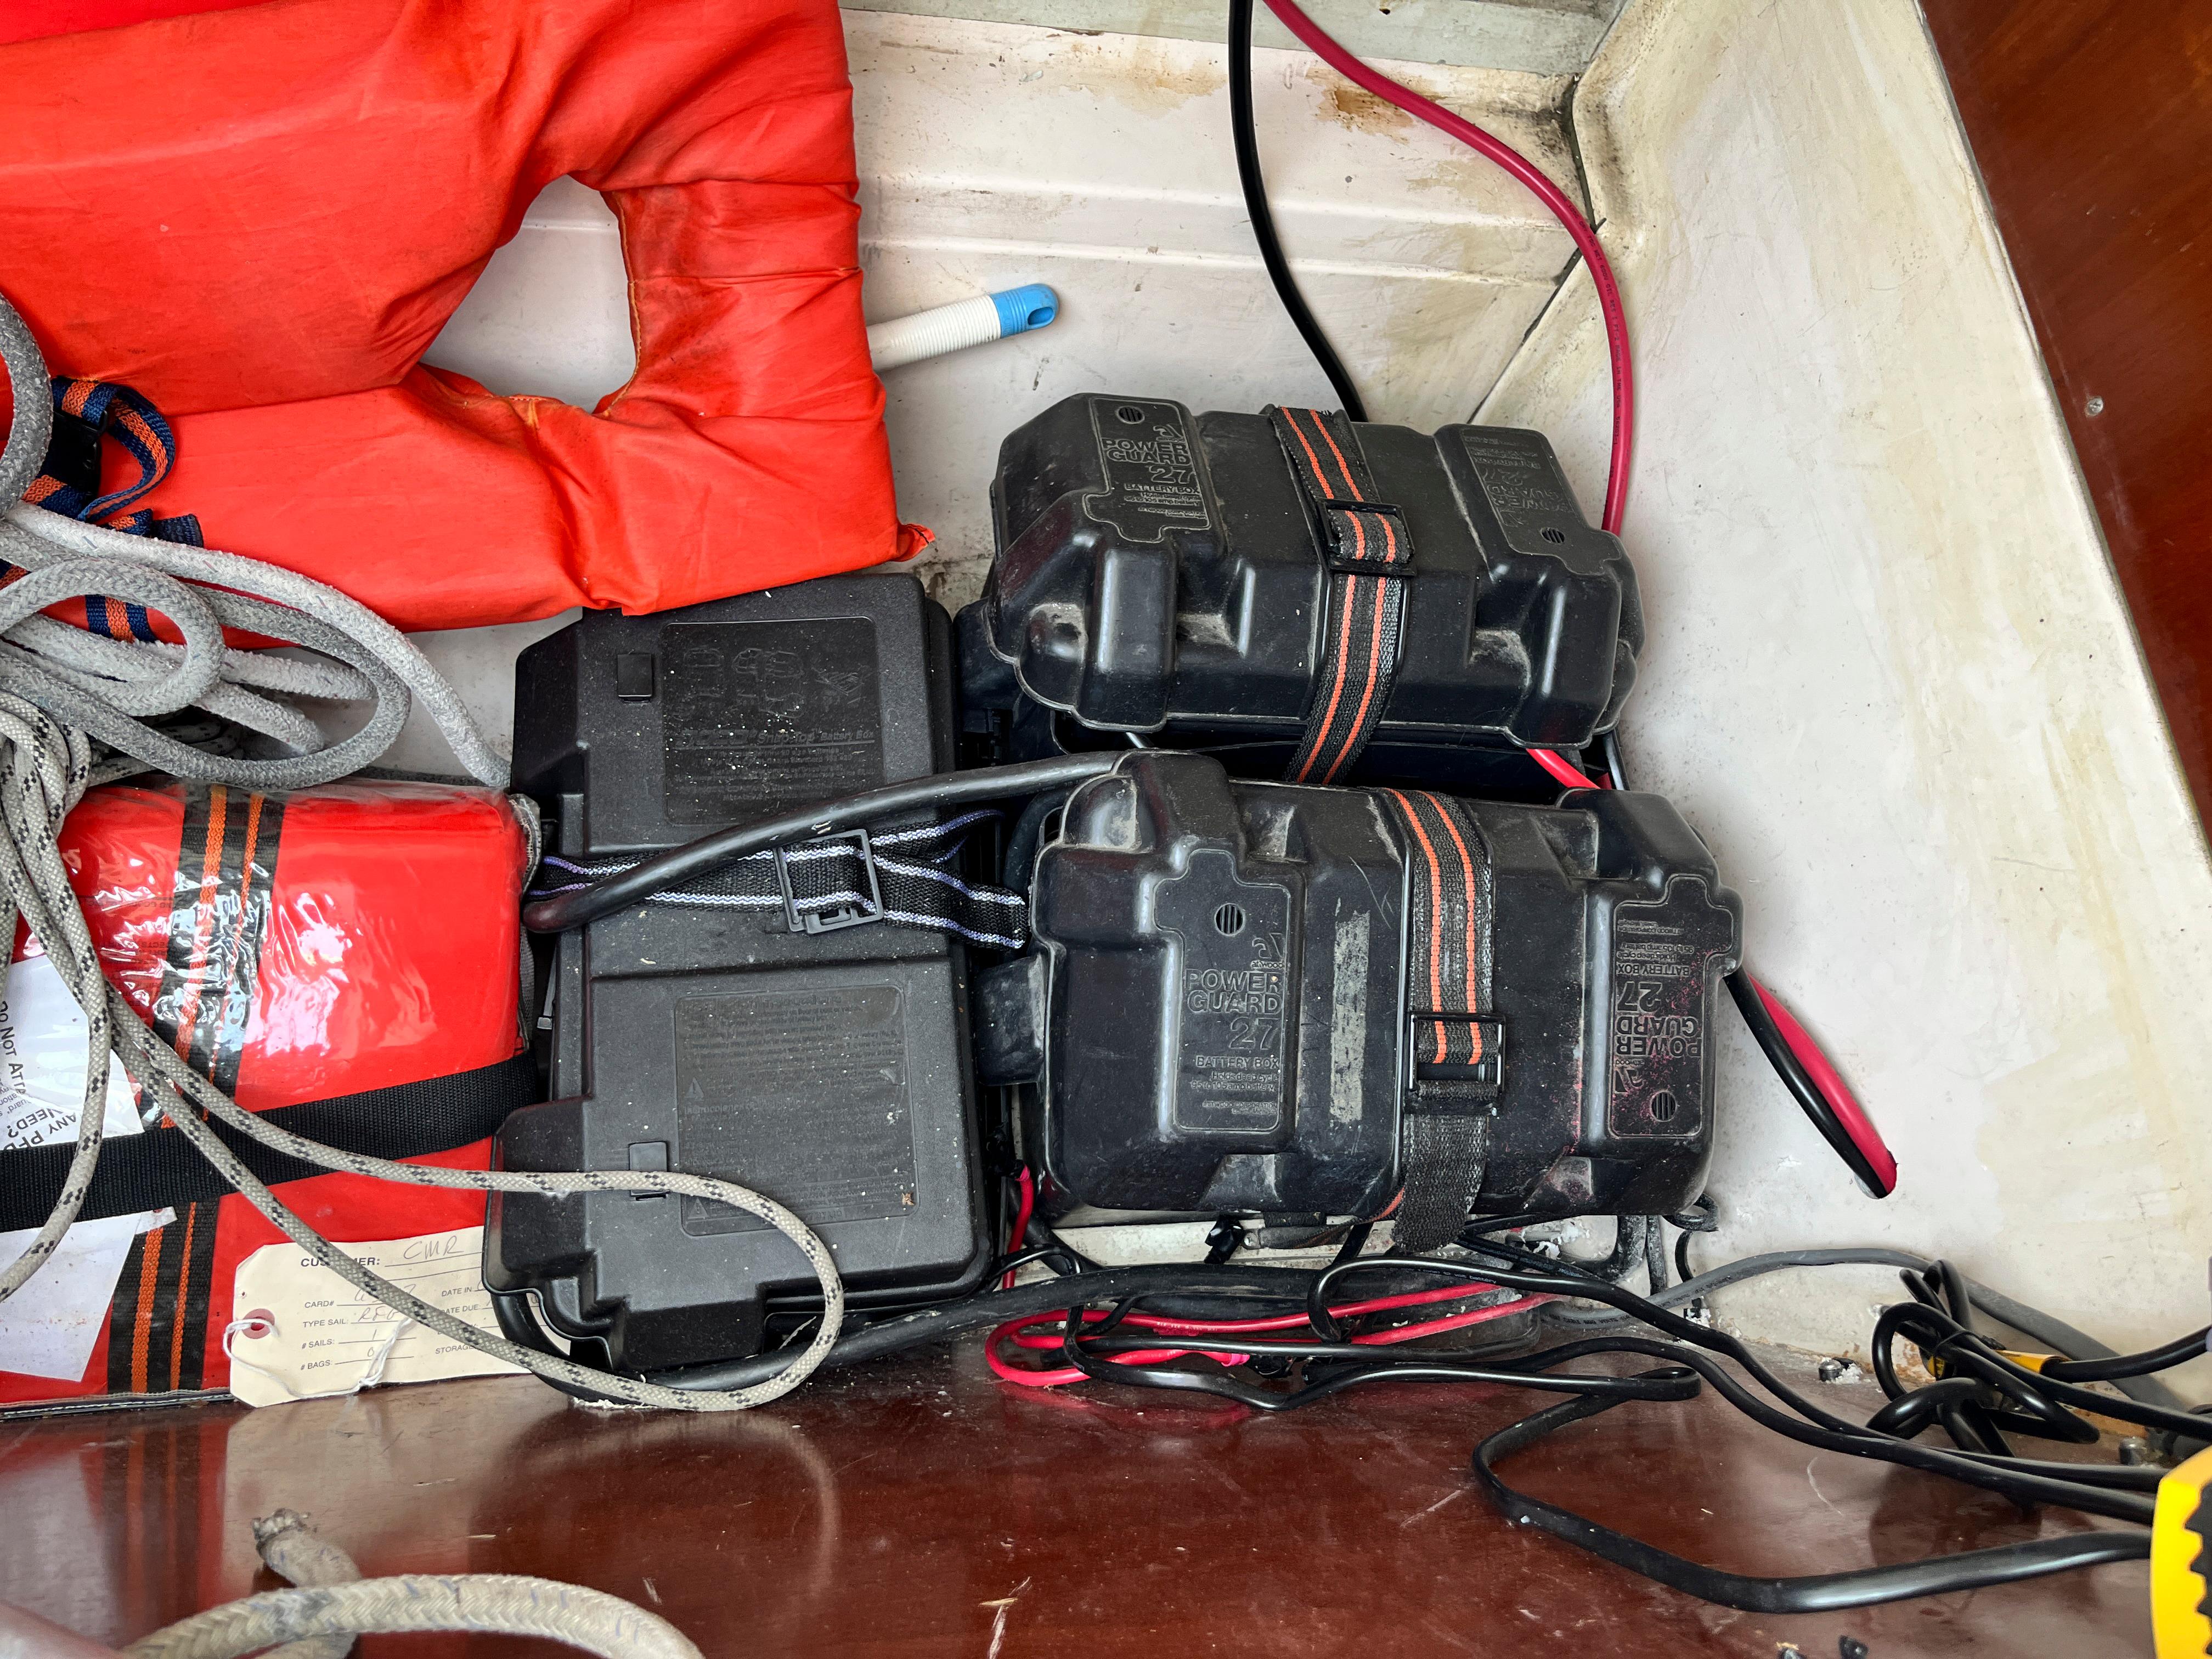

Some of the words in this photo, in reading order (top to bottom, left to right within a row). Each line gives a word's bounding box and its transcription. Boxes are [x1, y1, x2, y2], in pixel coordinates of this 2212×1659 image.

[1102, 438, 1189, 455] POWER
[1107, 447, 1192, 466] GUARD
[1149, 466, 1196, 484] 27
[1124, 483, 1175, 493] BATTERY
[1176, 486, 1201, 495] BOX
[1616, 962, 1639, 975] BOX
[1642, 964, 1690, 977] BATTERY
[1185, 969, 1283, 994] POWER
[1187, 990, 1283, 1014] GUARD
[1616, 981, 1662, 1012] 27
[1228, 1017, 1281, 1050] 27
[1616, 1015, 1699, 1037] GUARD
[1, 1026, 17, 1056] NOT
[1615, 1036, 1702, 1058] POWER
[1196, 1055, 1250, 1069] BATTERY
[1254, 1057, 1279, 1069] BOX
[48, 1114, 77, 1135] ANY
[403, 1235, 465, 1260] CMR
[301, 1257, 380, 1267] CUSER:
[442, 1288, 462, 1297] DATE
[304, 1300, 335, 1308] CARD#
[303, 1319, 325, 1328] TYPE
[308, 1339, 335, 1348] SAILS:
[307, 1360, 332, 1369] BAGS:
